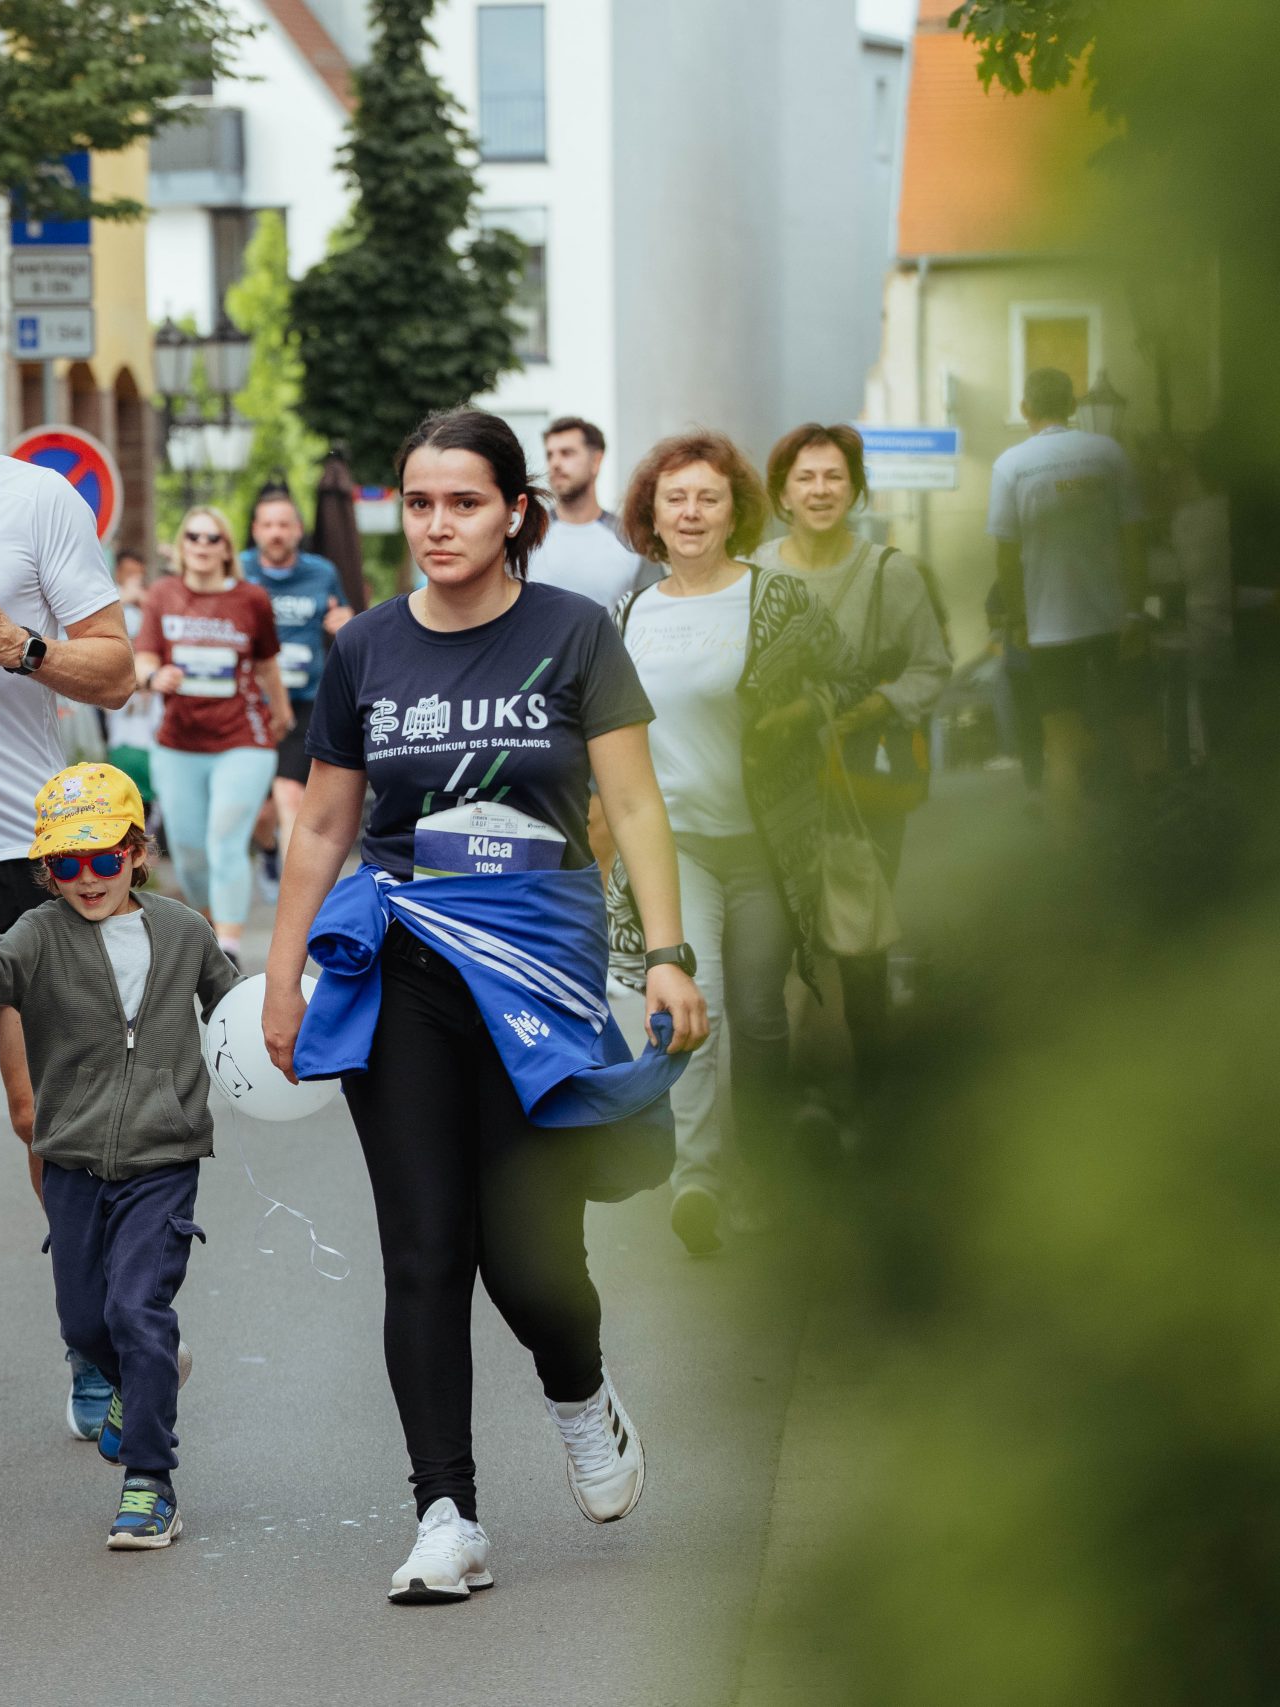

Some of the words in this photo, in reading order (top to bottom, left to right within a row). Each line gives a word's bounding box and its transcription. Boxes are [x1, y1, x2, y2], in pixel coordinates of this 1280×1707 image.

[462, 693, 549, 731] UKS
[470, 738, 488, 749] DES
[491, 738, 551, 749] SAARLANDES
[467, 836, 513, 859] Klea
[474, 861, 503, 875] 1034
[503, 1013, 536, 1047] JJPRINT
